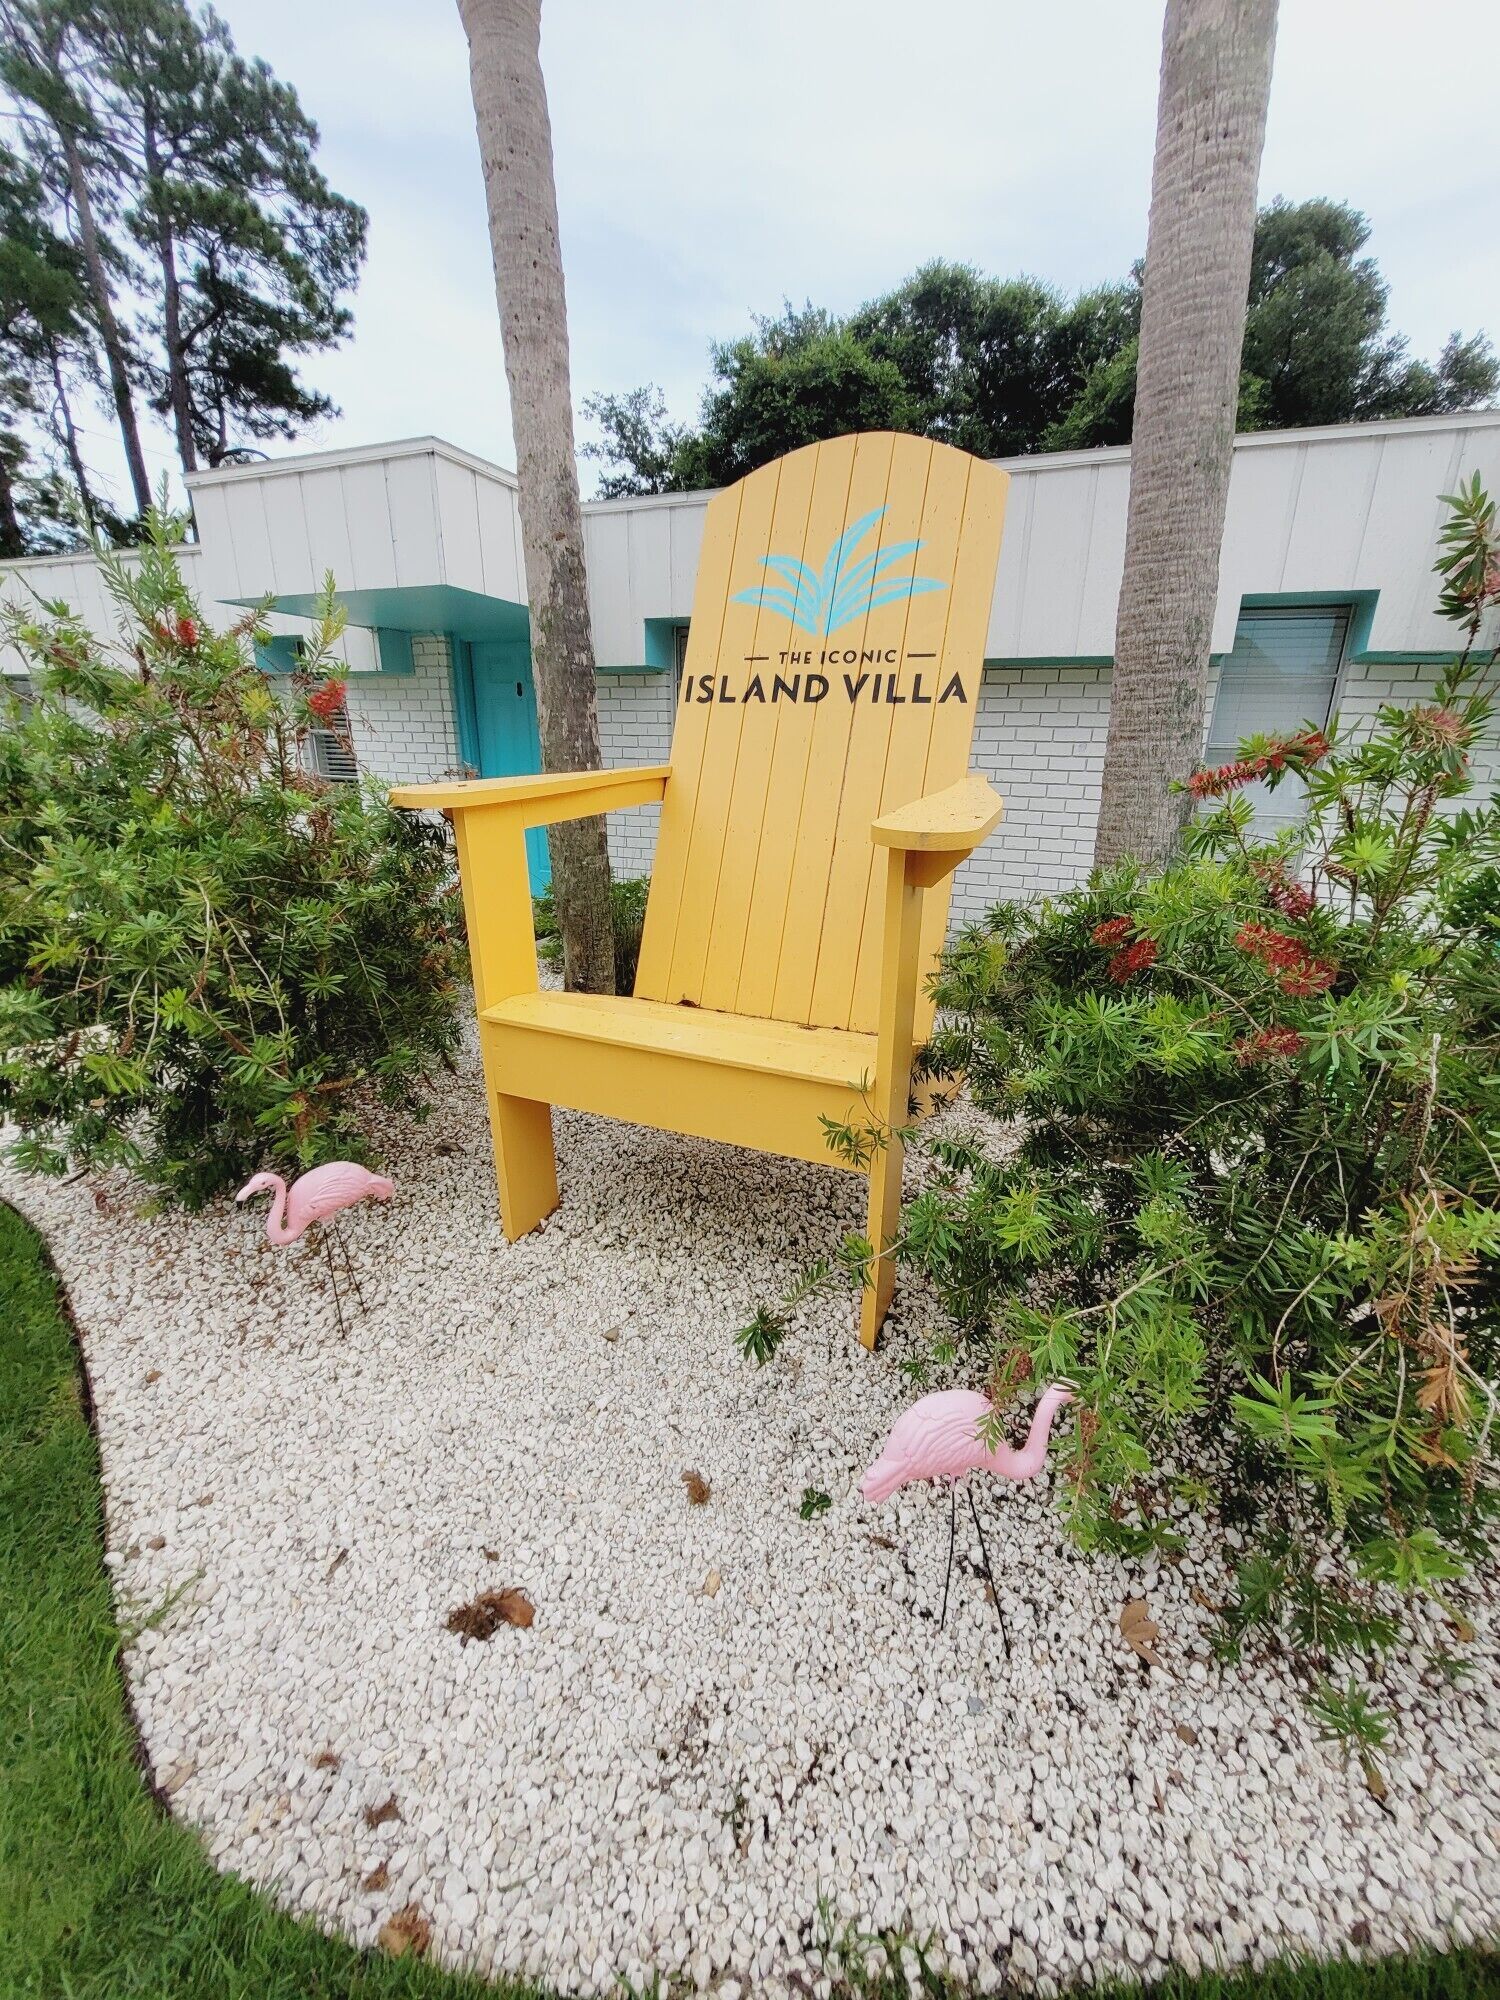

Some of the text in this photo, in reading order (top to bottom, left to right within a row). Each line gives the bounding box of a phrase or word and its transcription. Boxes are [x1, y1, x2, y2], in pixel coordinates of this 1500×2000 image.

[778, 649, 897, 664] THE ICONIC
[684, 671, 968, 703] ISLAND VILLA
